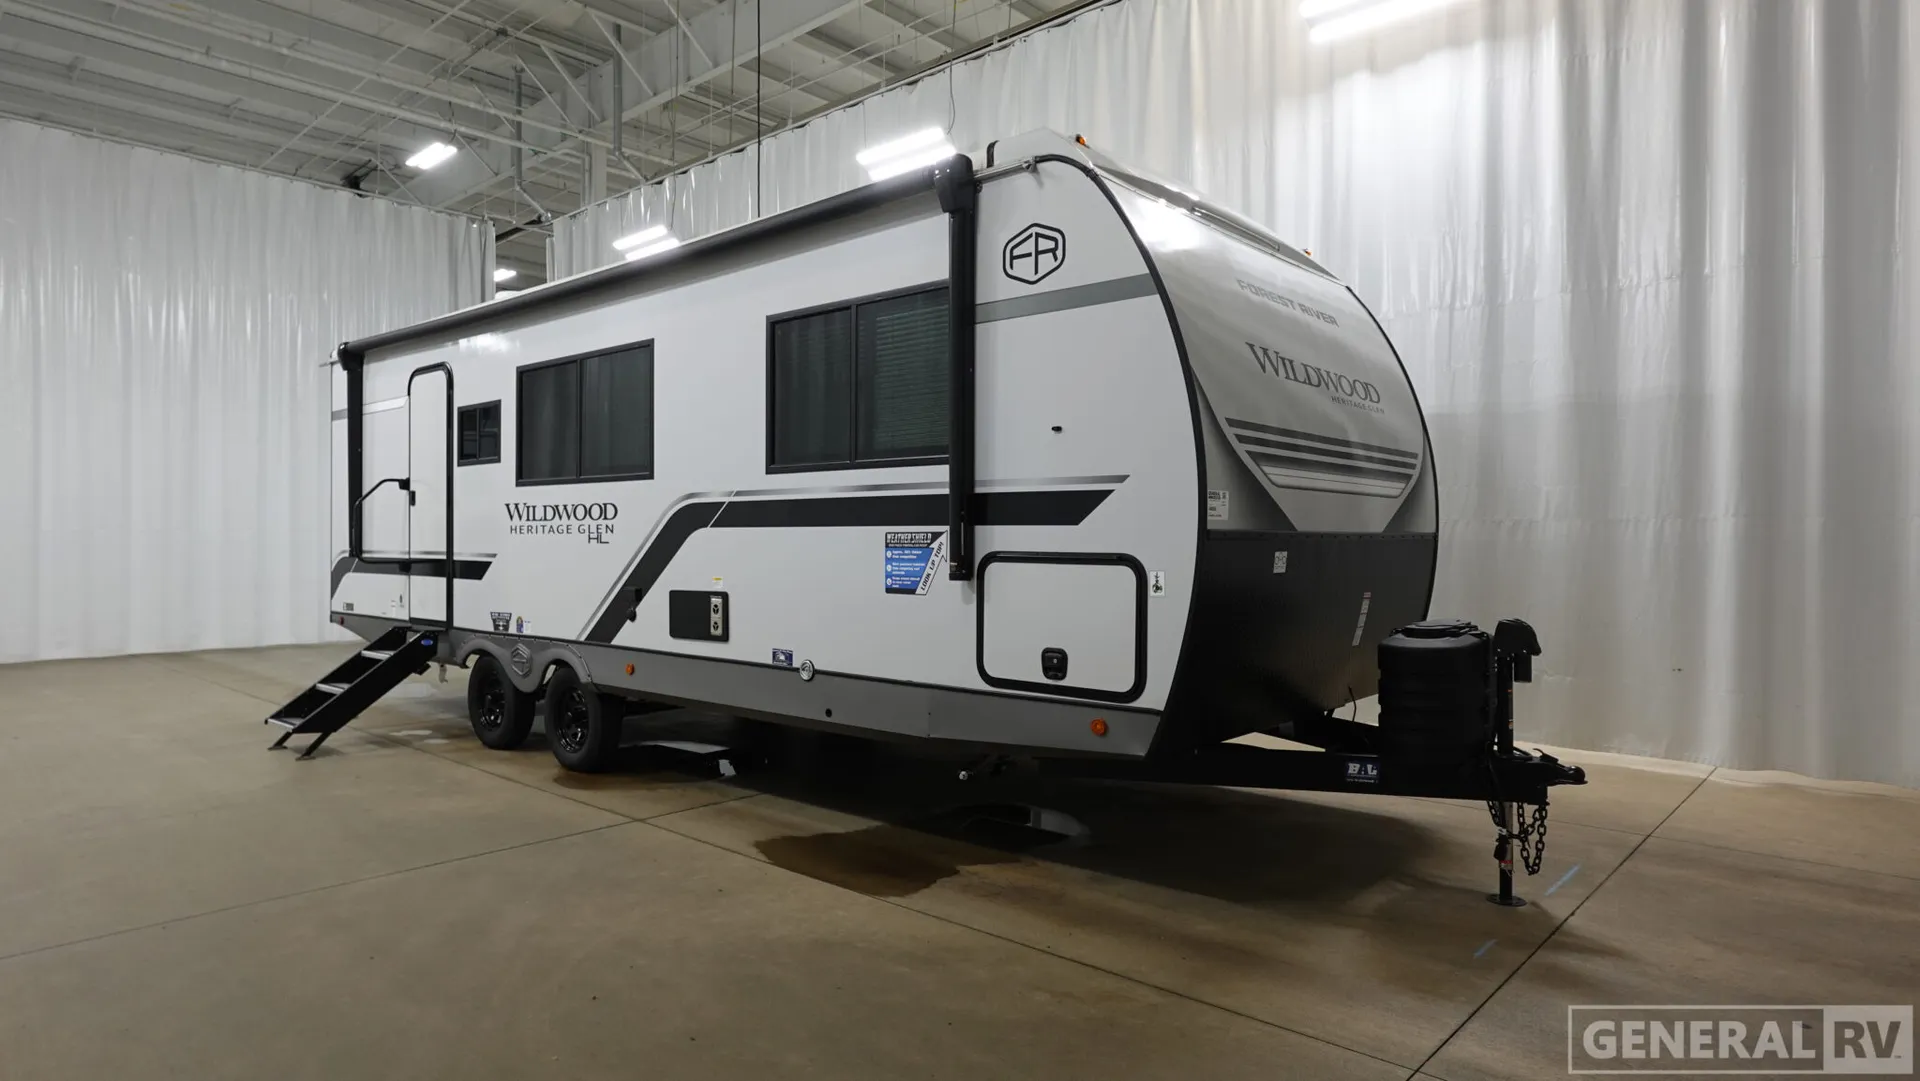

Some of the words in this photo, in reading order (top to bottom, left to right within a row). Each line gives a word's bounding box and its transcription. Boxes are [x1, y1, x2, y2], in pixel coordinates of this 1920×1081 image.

[1236, 279, 1299, 310] FOREST
[1299, 303, 1340, 328] RIVER
[1245, 341, 1381, 404] WILDWOOD
[1331, 395, 1368, 411] HERITAGE
[504, 502, 618, 522] WILDWOOD
[510, 524, 573, 535] HERITAGE
[577, 523, 614, 535] GLEN
[587, 534, 610, 544] HL
[920, 572, 932, 591] LOOK
